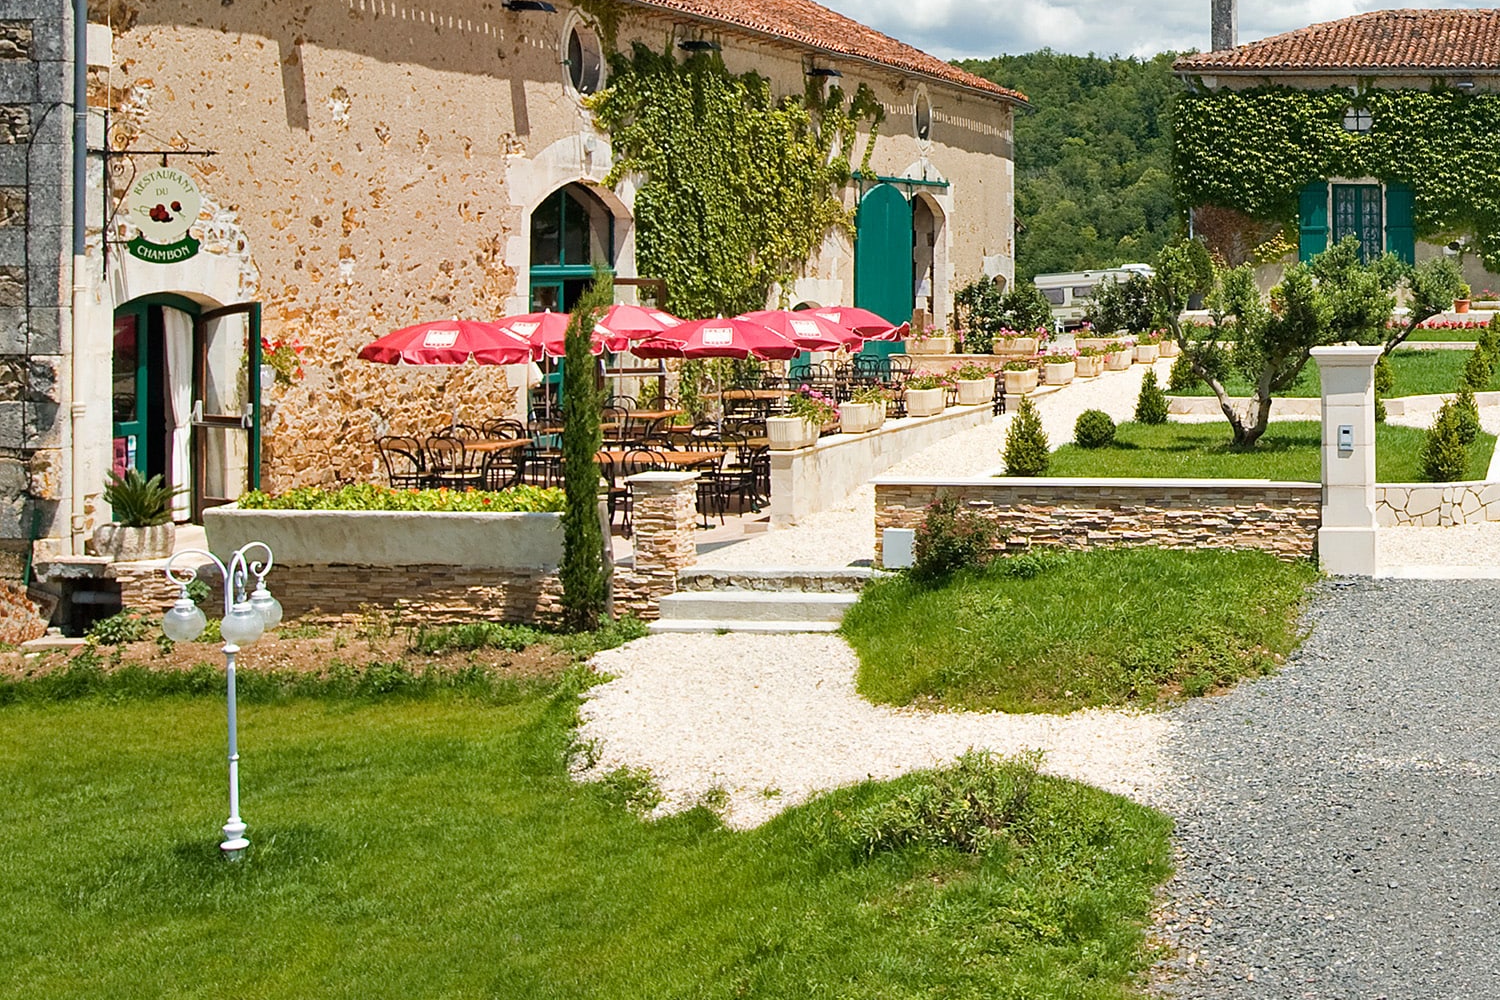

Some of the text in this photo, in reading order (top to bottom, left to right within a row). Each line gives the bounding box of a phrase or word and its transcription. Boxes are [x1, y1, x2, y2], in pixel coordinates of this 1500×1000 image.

[133, 170, 194, 196] RESTAURANT
[155, 187, 169, 196] DU
[137, 245, 190, 260] CHAMBON
